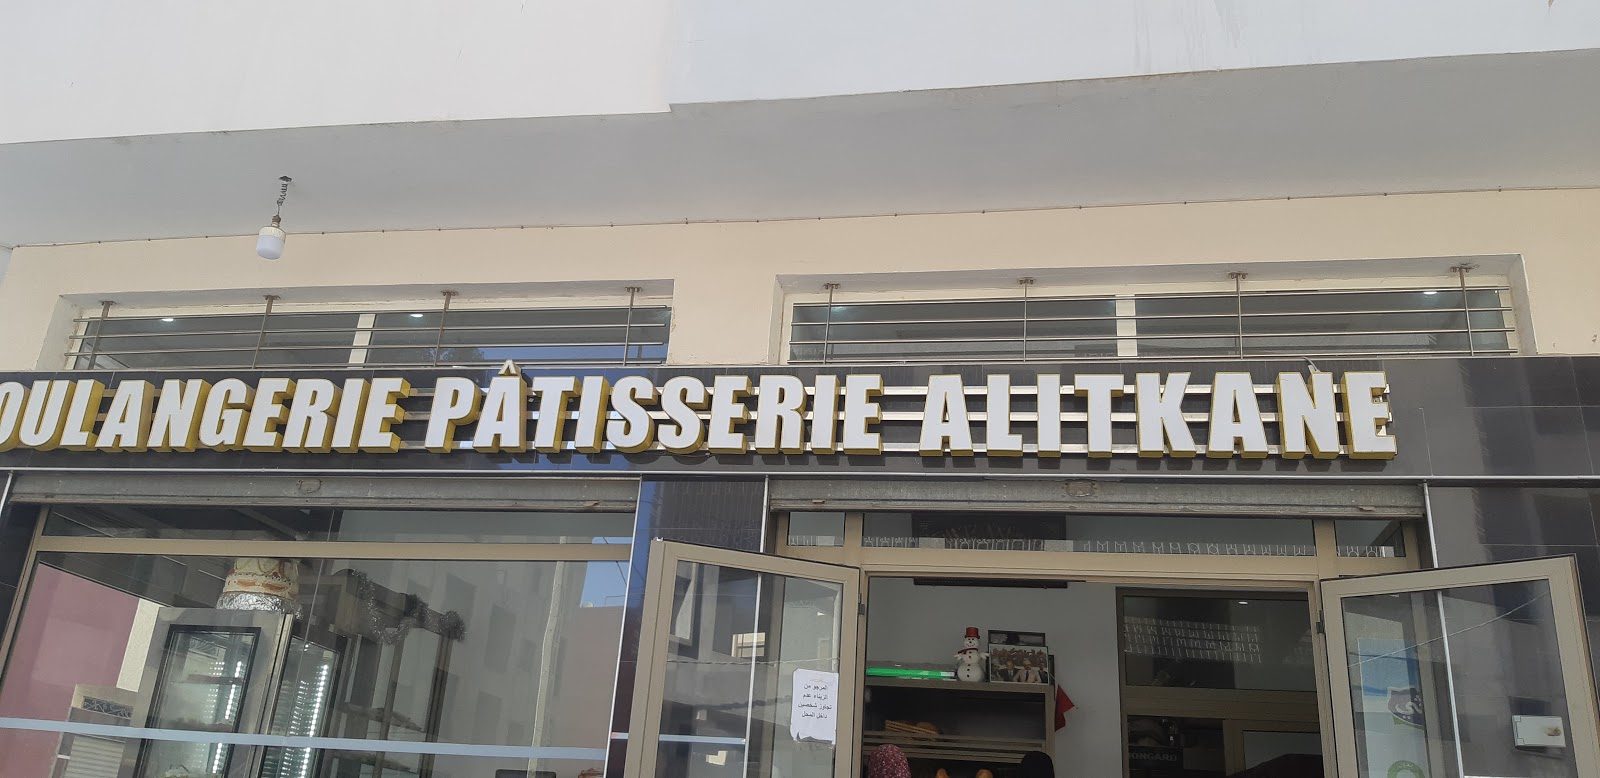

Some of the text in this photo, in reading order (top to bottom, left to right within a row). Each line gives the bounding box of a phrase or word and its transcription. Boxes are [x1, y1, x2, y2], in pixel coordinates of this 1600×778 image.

[425, 359, 883, 455] PÂTISSERIE
[919, 371, 1397, 459] ALITKANE
[1129, 752, 1177, 762] ONGARD
